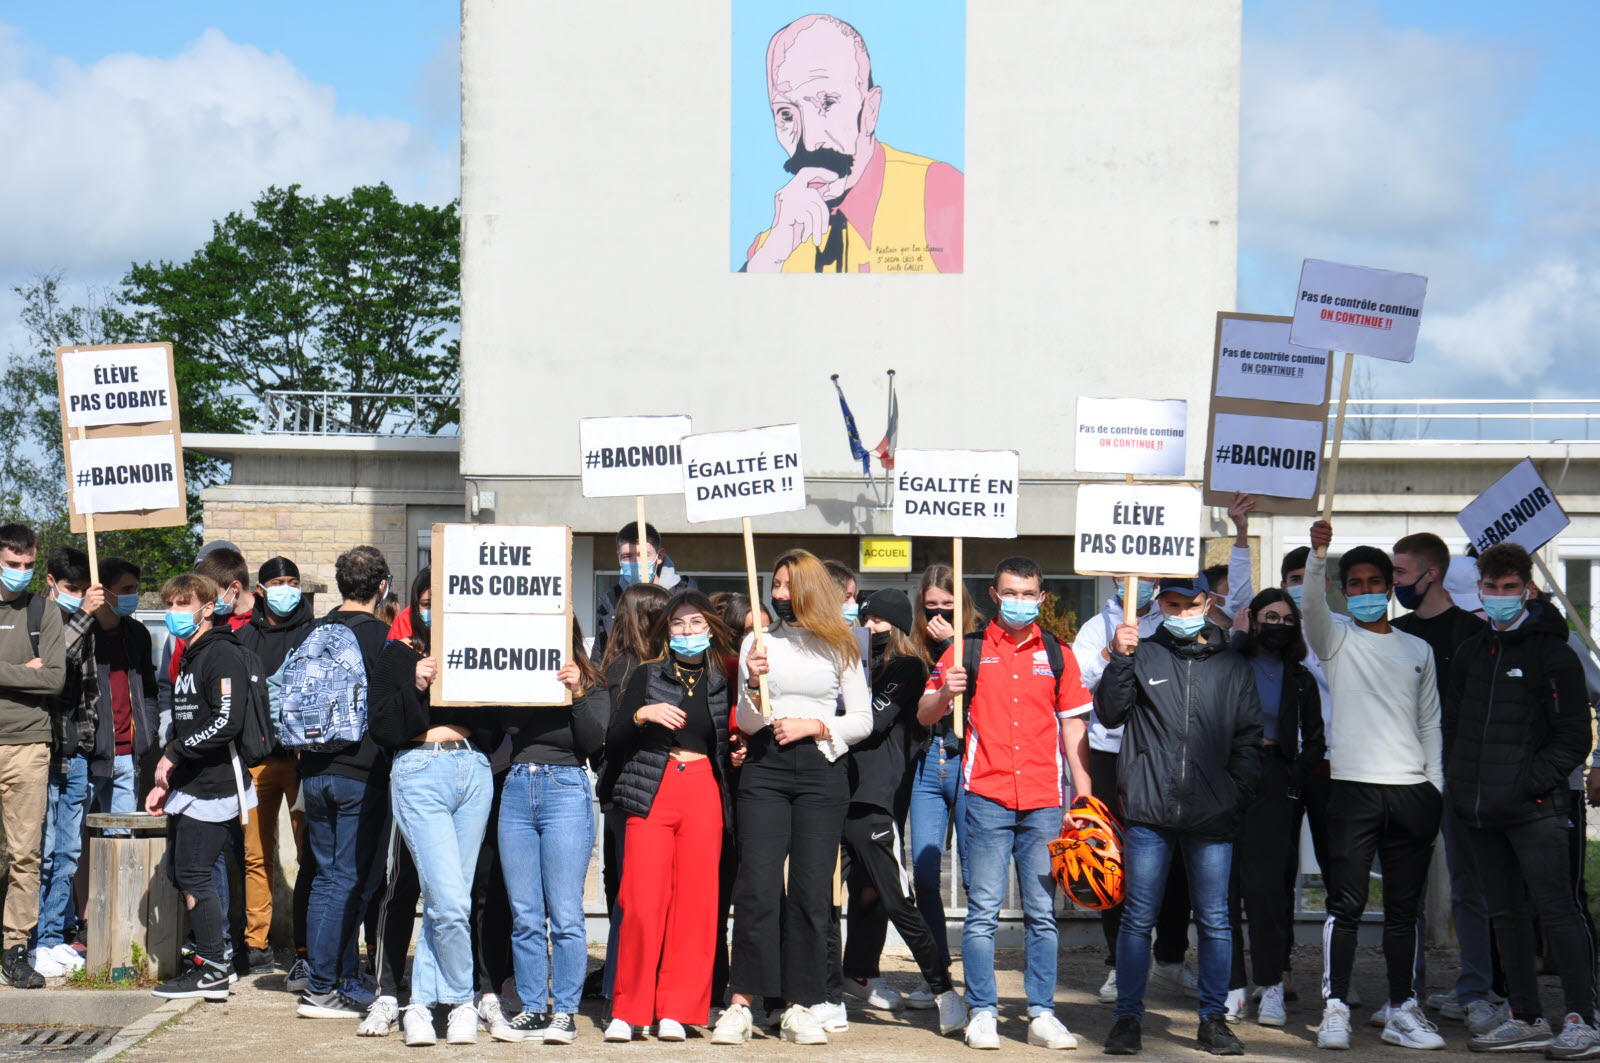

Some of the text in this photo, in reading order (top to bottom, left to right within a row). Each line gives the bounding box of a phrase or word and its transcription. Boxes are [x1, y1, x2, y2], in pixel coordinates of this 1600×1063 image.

[1301, 290, 1420, 318] Pas de contrôle continu
[1320, 308, 1393, 330] ON CONTINUE !!
[1222, 347, 1326, 365] Pas de contrôle continu
[94, 363, 139, 385] ÉLÈVE
[1241, 362, 1304, 378] ON CONTINUE !!
[70, 389, 168, 412] PAS COBAYE
[1079, 424, 1184, 437] Pas de contrôle continu
[1099, 438, 1164, 450] ON CONTINUE !!
[687, 451, 798, 479] ÉGALITÉ EN
[1216, 444, 1316, 471] #BACNOIR
[76, 463, 173, 487] #BACNOIR
[899, 471, 1013, 494] ÉGALITÉ EN
[696, 476, 793, 501] DANGER !!
[905, 500, 1005, 517] DANGER !!
[1113, 501, 1165, 526] ÉLÈVE
[1477, 486, 1552, 552] #BACNOIR
[479, 542, 531, 566] ÉLÈVE
[864, 549, 908, 558] ACCUEIL
[1080, 533, 1195, 557] PAS COBAYE
[449, 575, 562, 596] PAS COBAYE
[447, 647, 561, 671] #BACNOIR
[185, 726, 218, 746] STATES
